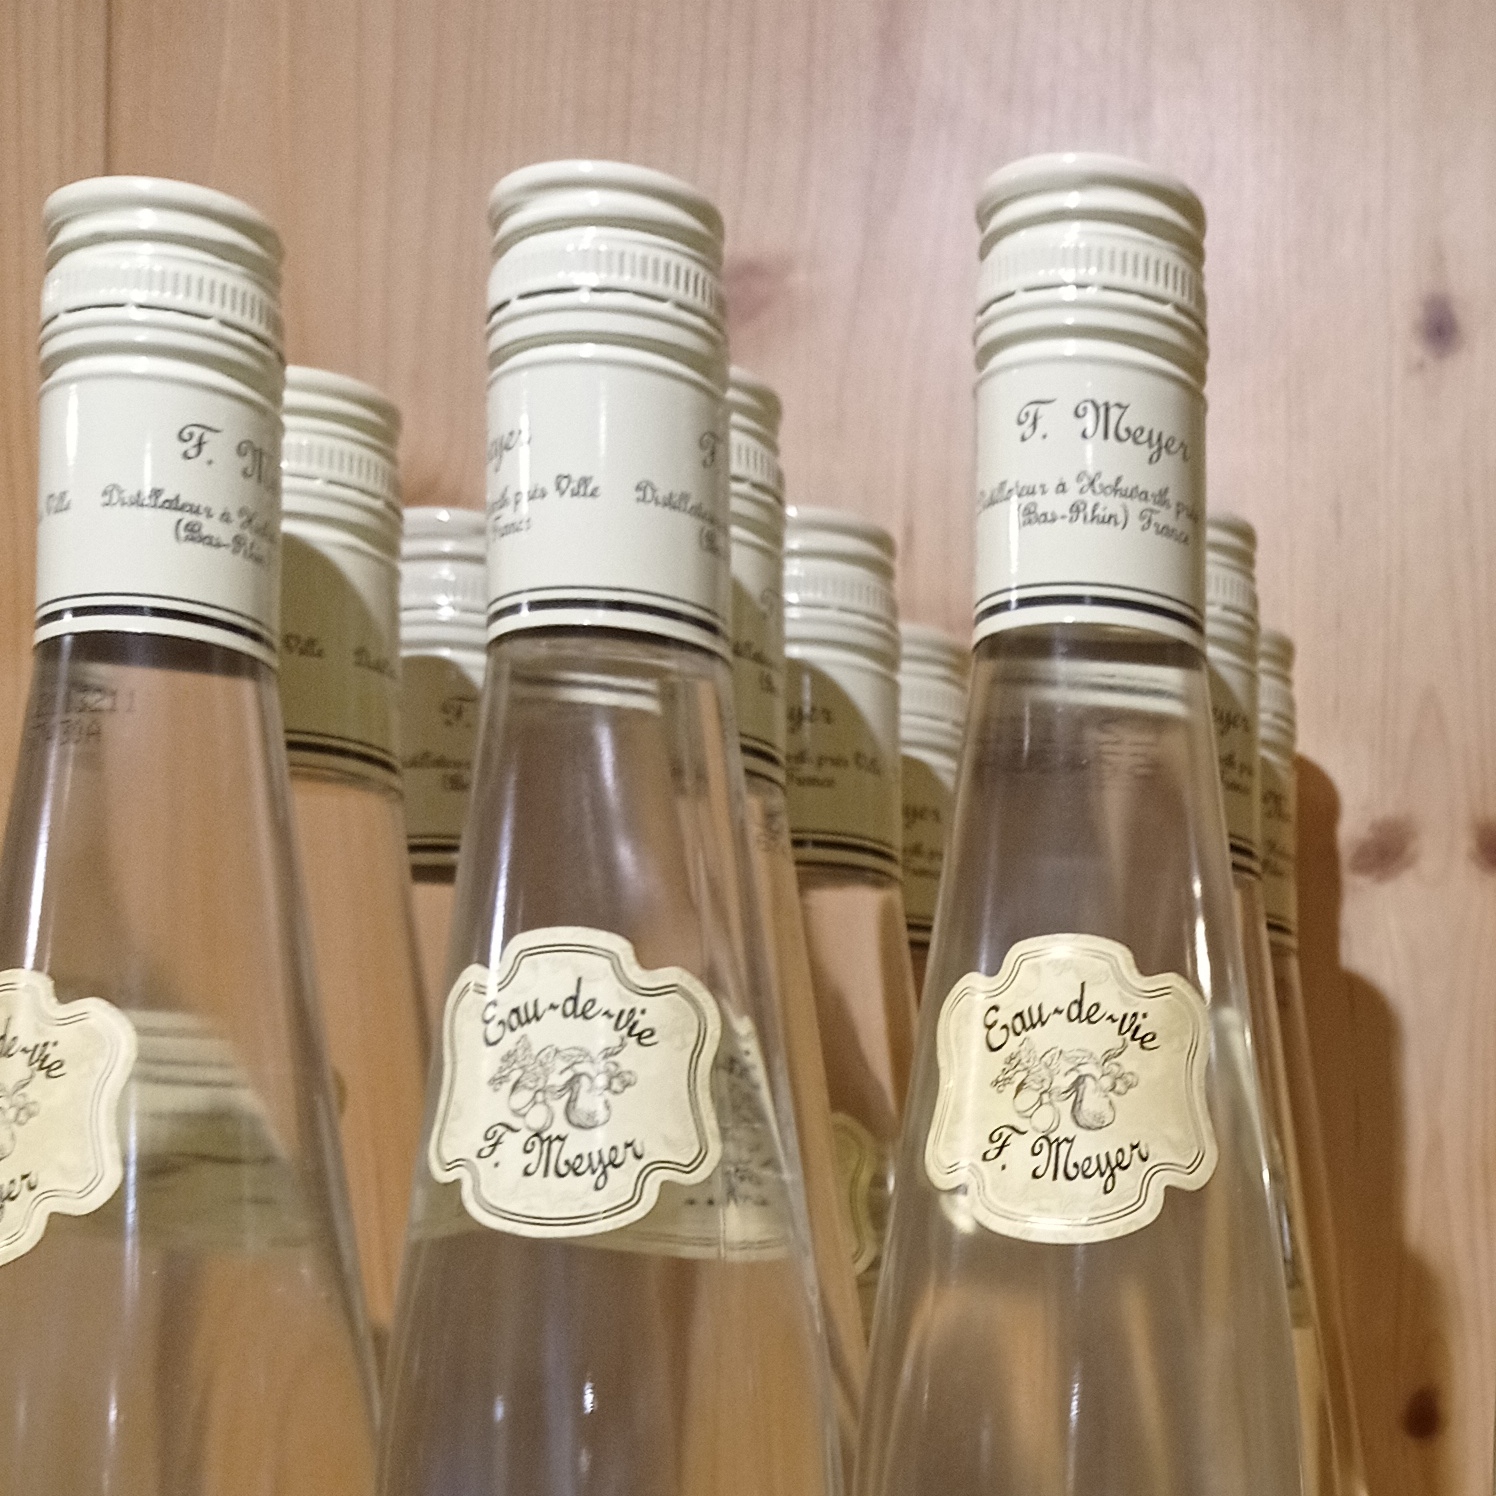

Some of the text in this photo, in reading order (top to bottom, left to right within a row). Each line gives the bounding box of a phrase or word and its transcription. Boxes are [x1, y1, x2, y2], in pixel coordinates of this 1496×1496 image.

[177, 423, 223, 466] F.
[1016, 398, 1191, 465] F. Meyer
[476, 1121, 645, 1192] F. Meyer
[981, 1123, 1151, 1196] F. Meyer
